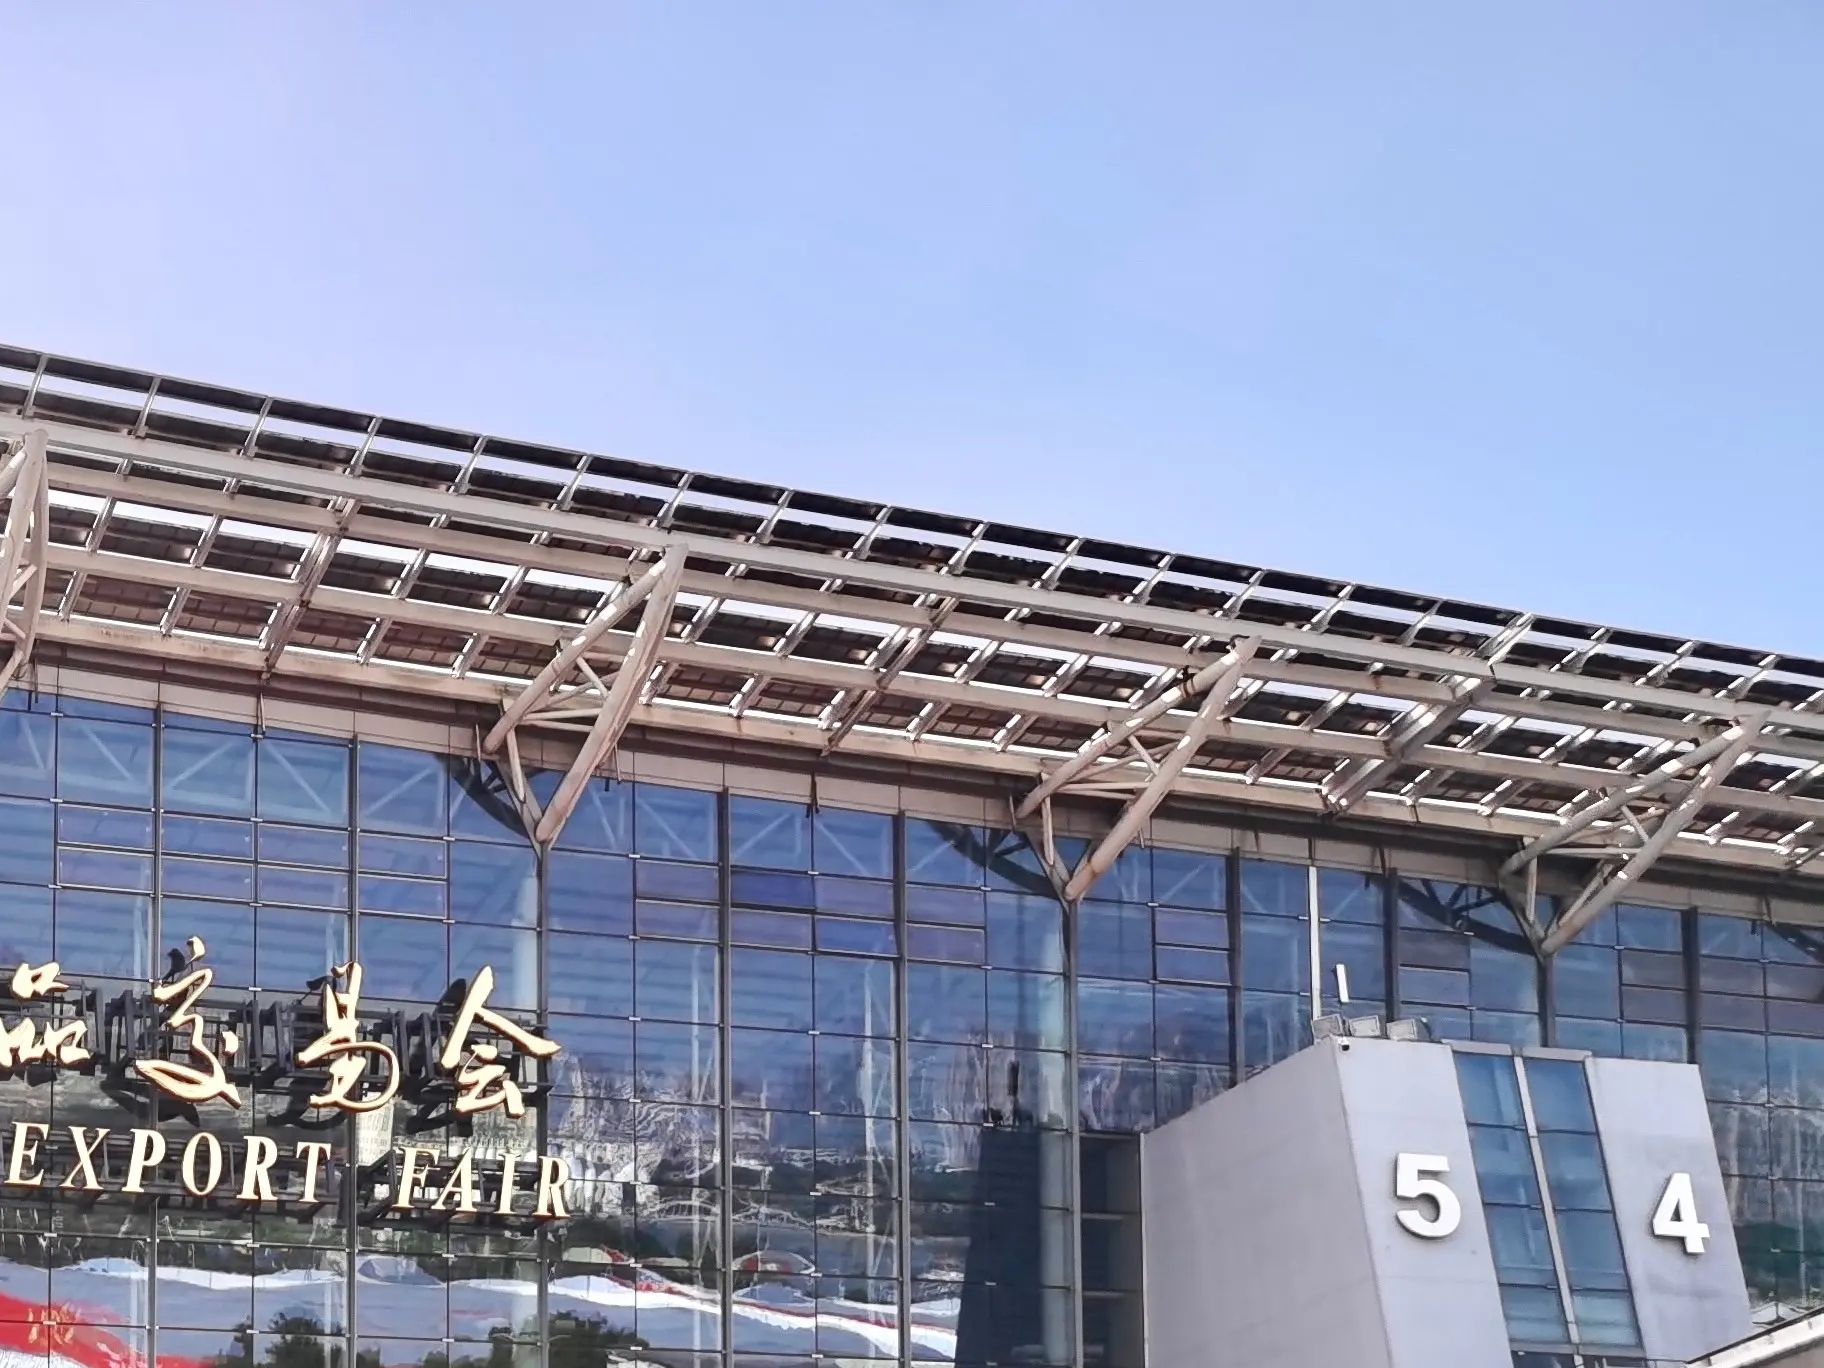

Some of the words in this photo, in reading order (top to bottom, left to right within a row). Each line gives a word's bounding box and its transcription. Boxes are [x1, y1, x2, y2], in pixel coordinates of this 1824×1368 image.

[4, 1120, 332, 1203] EXPORT
[393, 1146, 571, 1219] FAIR
[1395, 1152, 1461, 1239] 5
[1652, 1171, 1711, 1255] 4
